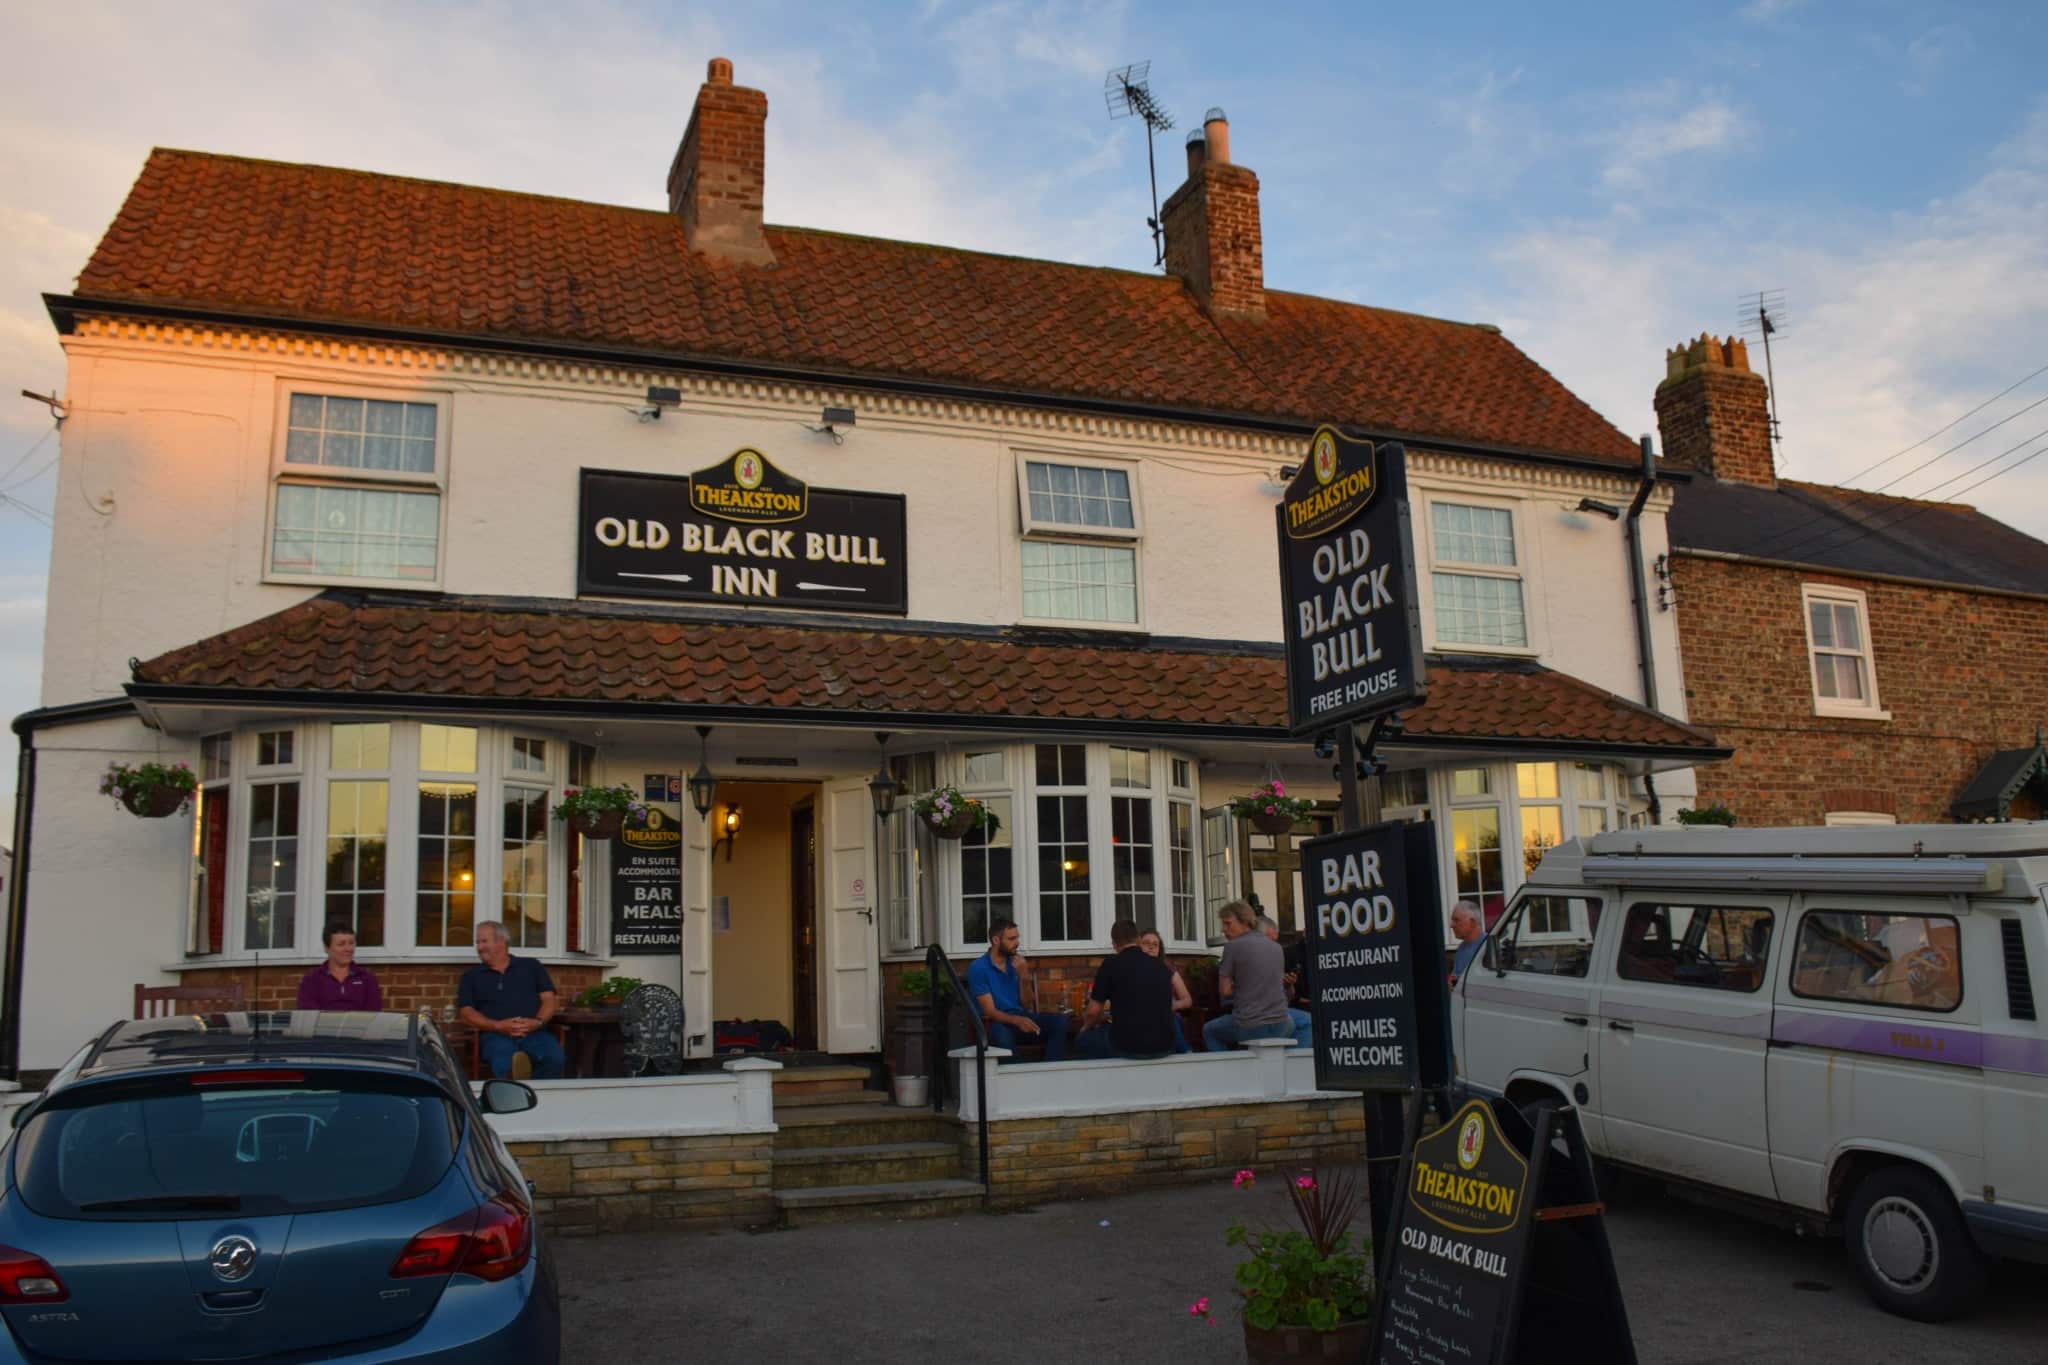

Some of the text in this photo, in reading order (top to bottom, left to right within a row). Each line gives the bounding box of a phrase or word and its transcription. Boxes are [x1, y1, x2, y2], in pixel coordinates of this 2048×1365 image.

[695, 484, 801, 512] THEAKSTON
[1289, 466, 1370, 528] THEAKSTON
[595, 516, 887, 566] OLD BLACK BULL
[1312, 528, 1371, 584] OLD
[712, 564, 778, 598] INN
[1298, 562, 1394, 640] BLACK
[1311, 621, 1382, 682] BULL
[1309, 668, 1398, 715] FREE HOUSE
[617, 867, 681, 876] ACCOMMODATI
[632, 857, 677, 865] EN SUITE
[1321, 850, 1384, 896] BAR
[634, 887, 673, 901] BAR
[1317, 895, 1395, 940] FOOD
[1318, 945, 1401, 970] RESTAURANT
[1321, 982, 1404, 1003] ACCOMMODATION
[1331, 1018, 1397, 1040] FAMILIES
[1329, 1046, 1404, 1067] WELCOME
[1416, 1162, 1516, 1217] THEAKSTON
[1401, 1226, 1508, 1277] OLD BLACK BULL
[28, 1312, 80, 1322] ASTRA
